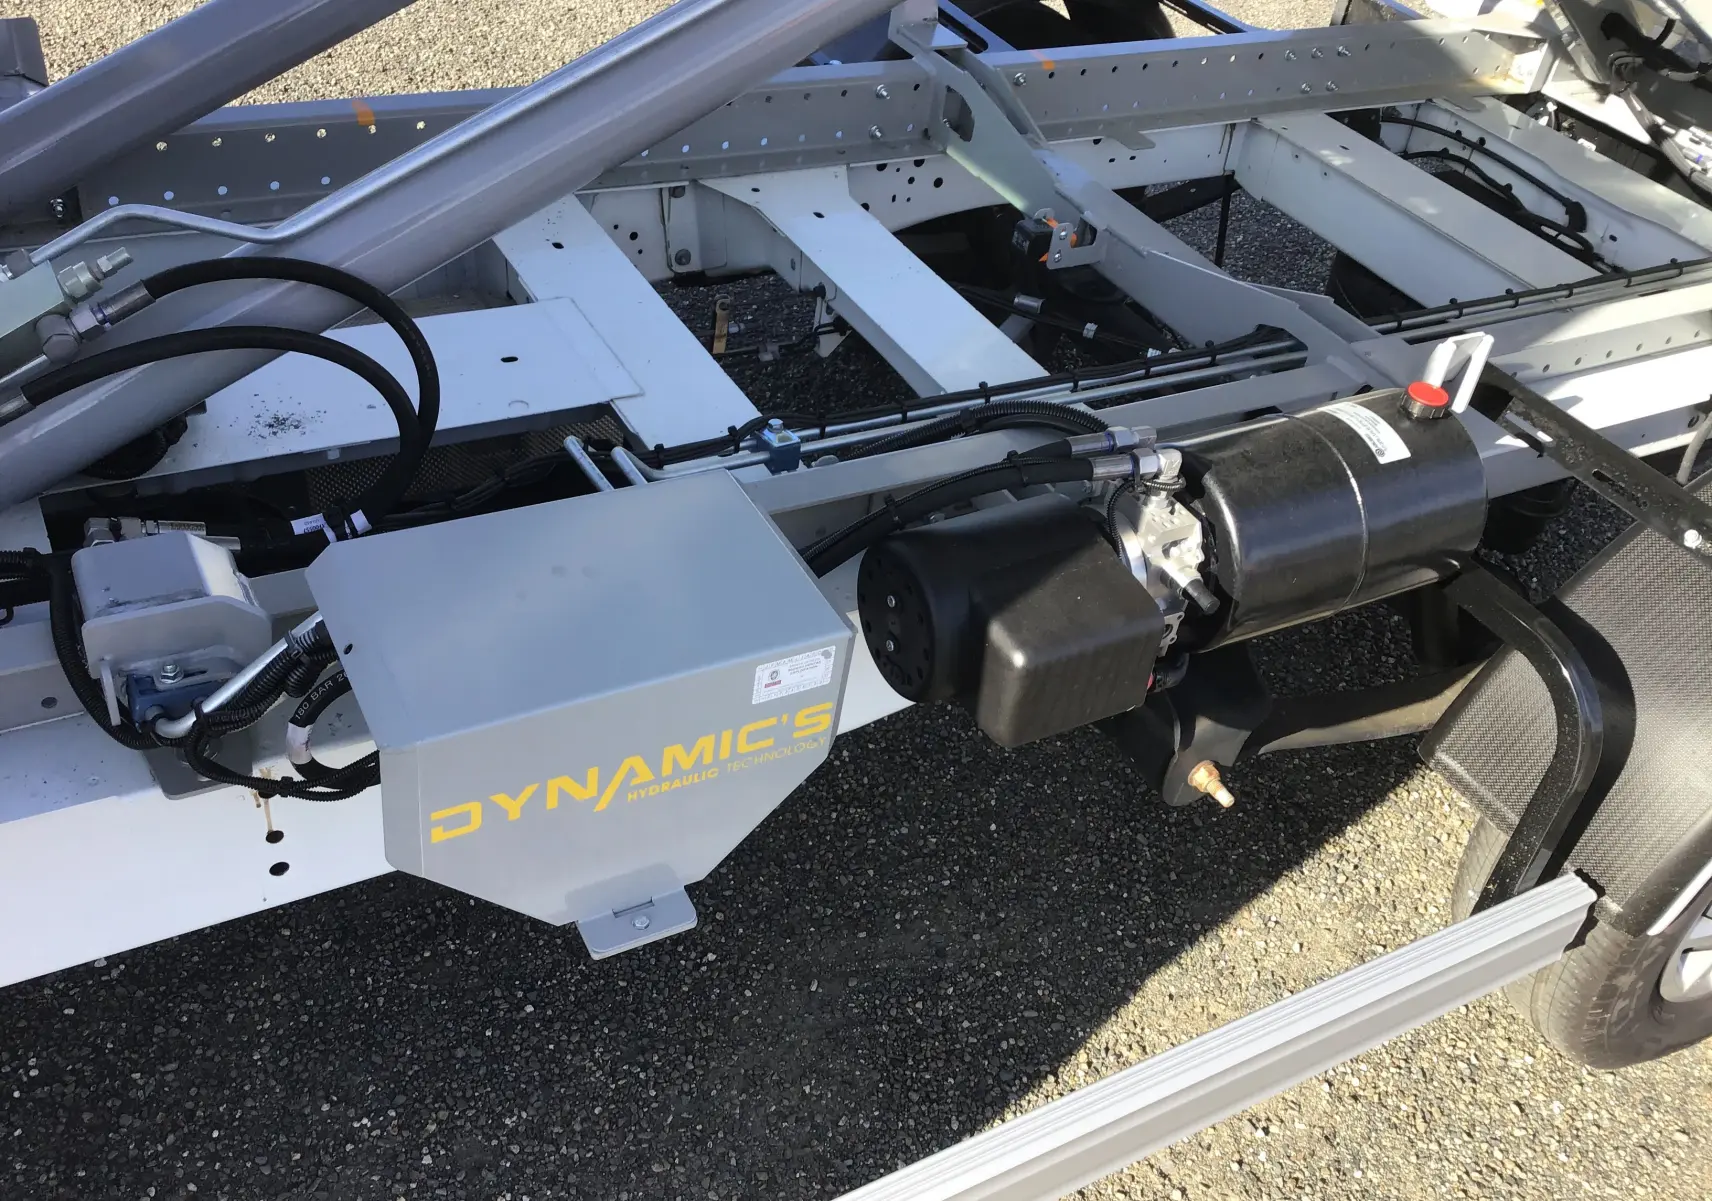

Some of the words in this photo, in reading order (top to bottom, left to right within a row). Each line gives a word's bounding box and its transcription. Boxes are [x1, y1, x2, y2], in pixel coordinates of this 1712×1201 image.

[295, 701, 310, 720] 180
[310, 680, 334, 701] BAR
[430, 702, 833, 843] DYNAMIC'S
[627, 767, 720, 802] HYDRAULIC
[727, 736, 826, 773] TECHNOLOGY
